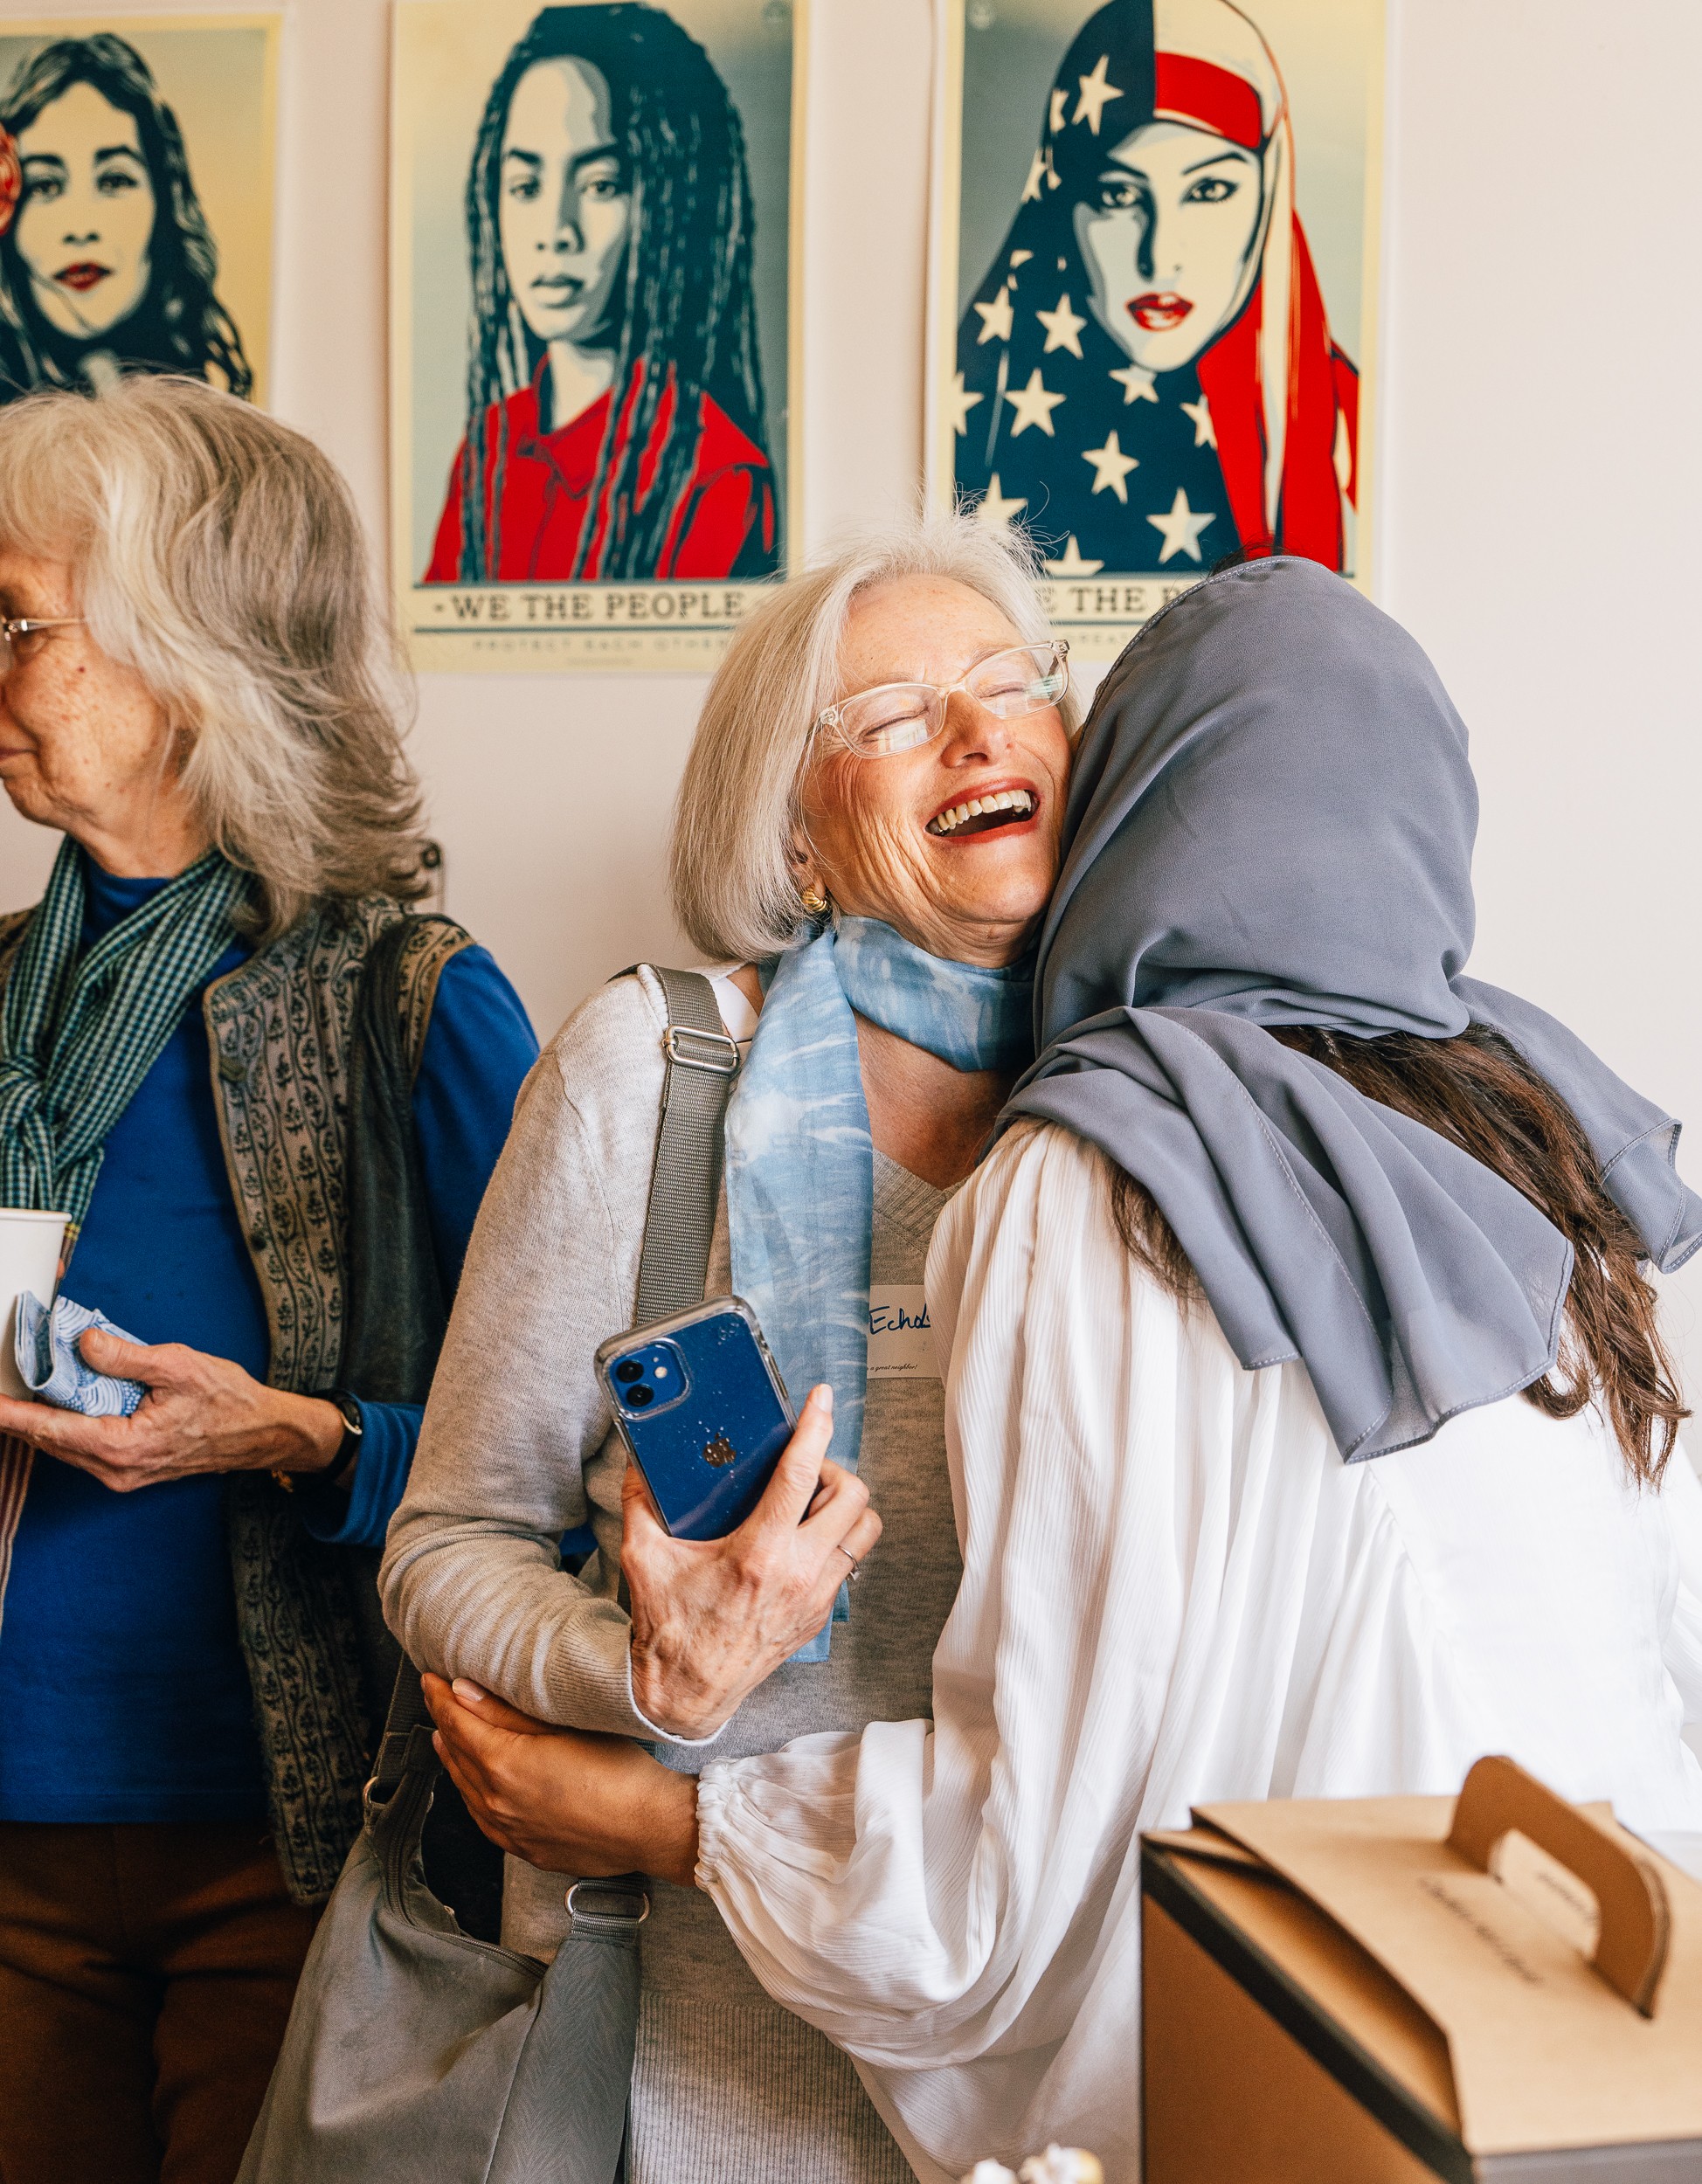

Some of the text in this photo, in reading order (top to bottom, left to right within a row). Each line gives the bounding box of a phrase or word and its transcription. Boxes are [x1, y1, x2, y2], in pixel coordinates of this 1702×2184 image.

[450, 591, 744, 621] WE THE PEOPLE
[1068, 586, 1146, 612] THE
[891, 1363, 918, 1372] neighbor!
